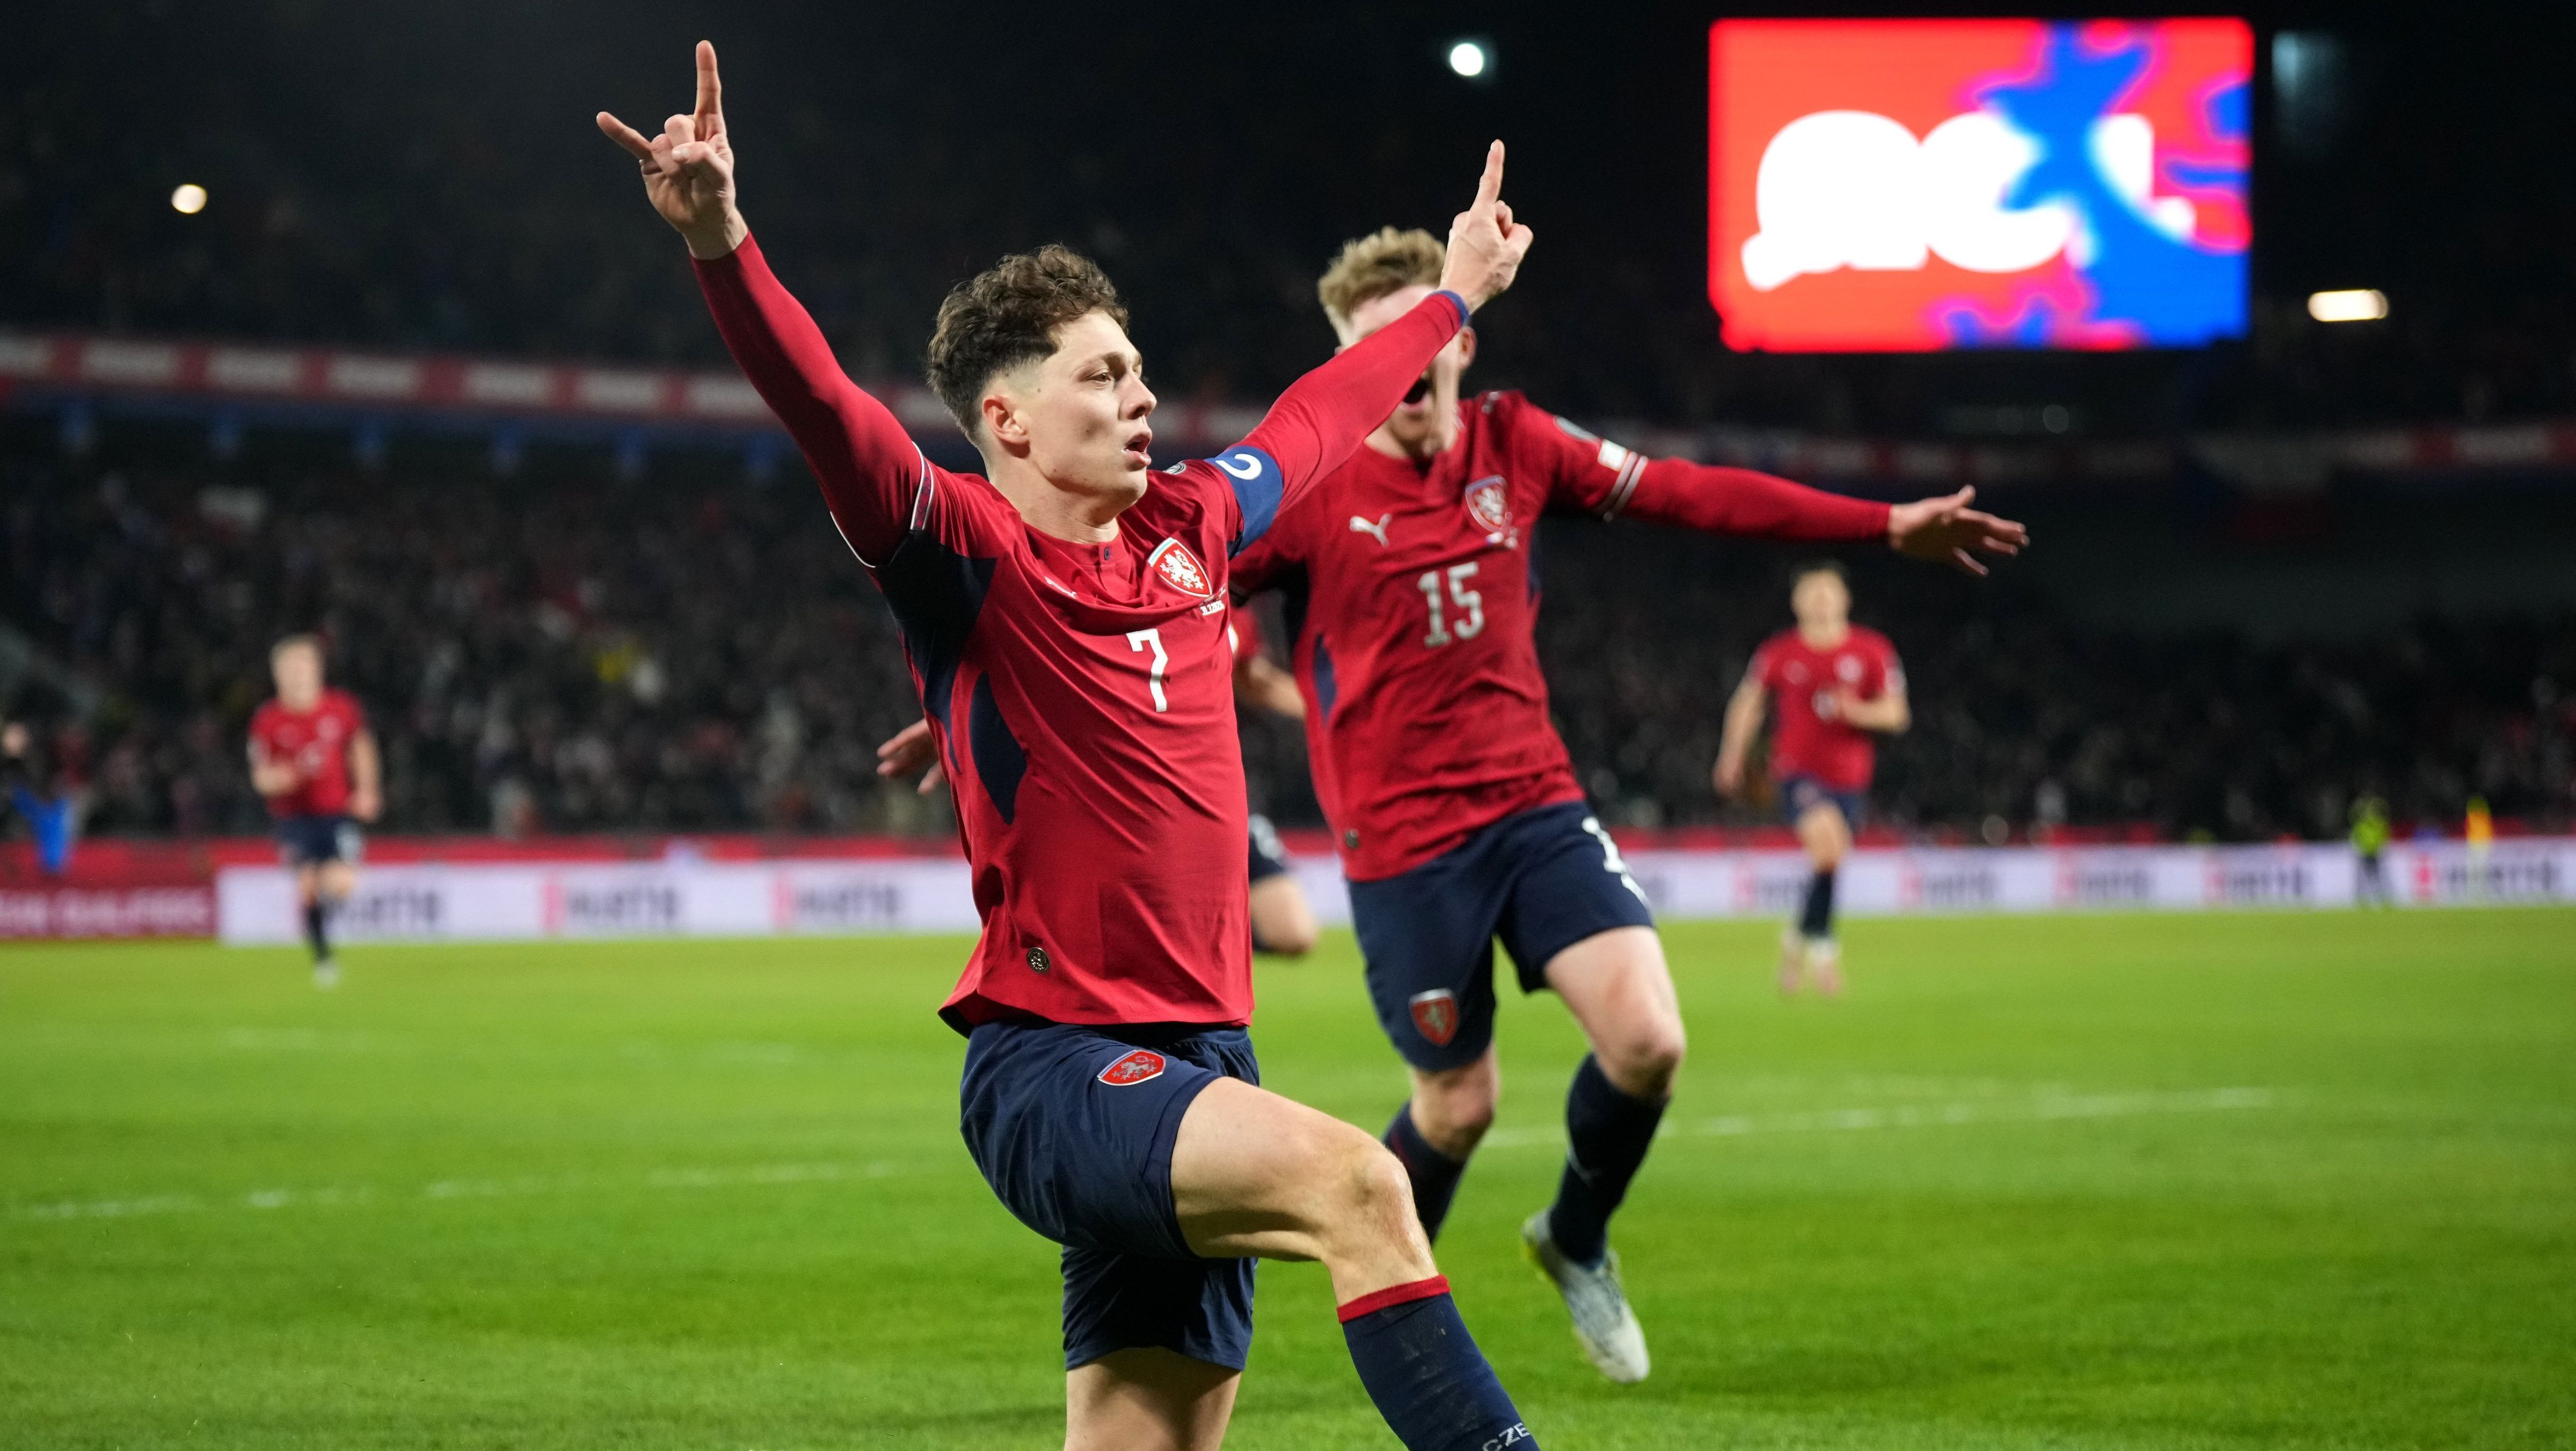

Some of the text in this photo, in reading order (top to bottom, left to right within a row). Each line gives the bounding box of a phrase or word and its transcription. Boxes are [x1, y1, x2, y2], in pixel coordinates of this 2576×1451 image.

[1417, 561, 1484, 647] 15
[1126, 628, 1168, 713] 7
[1482, 1422, 1530, 1451] CZE
